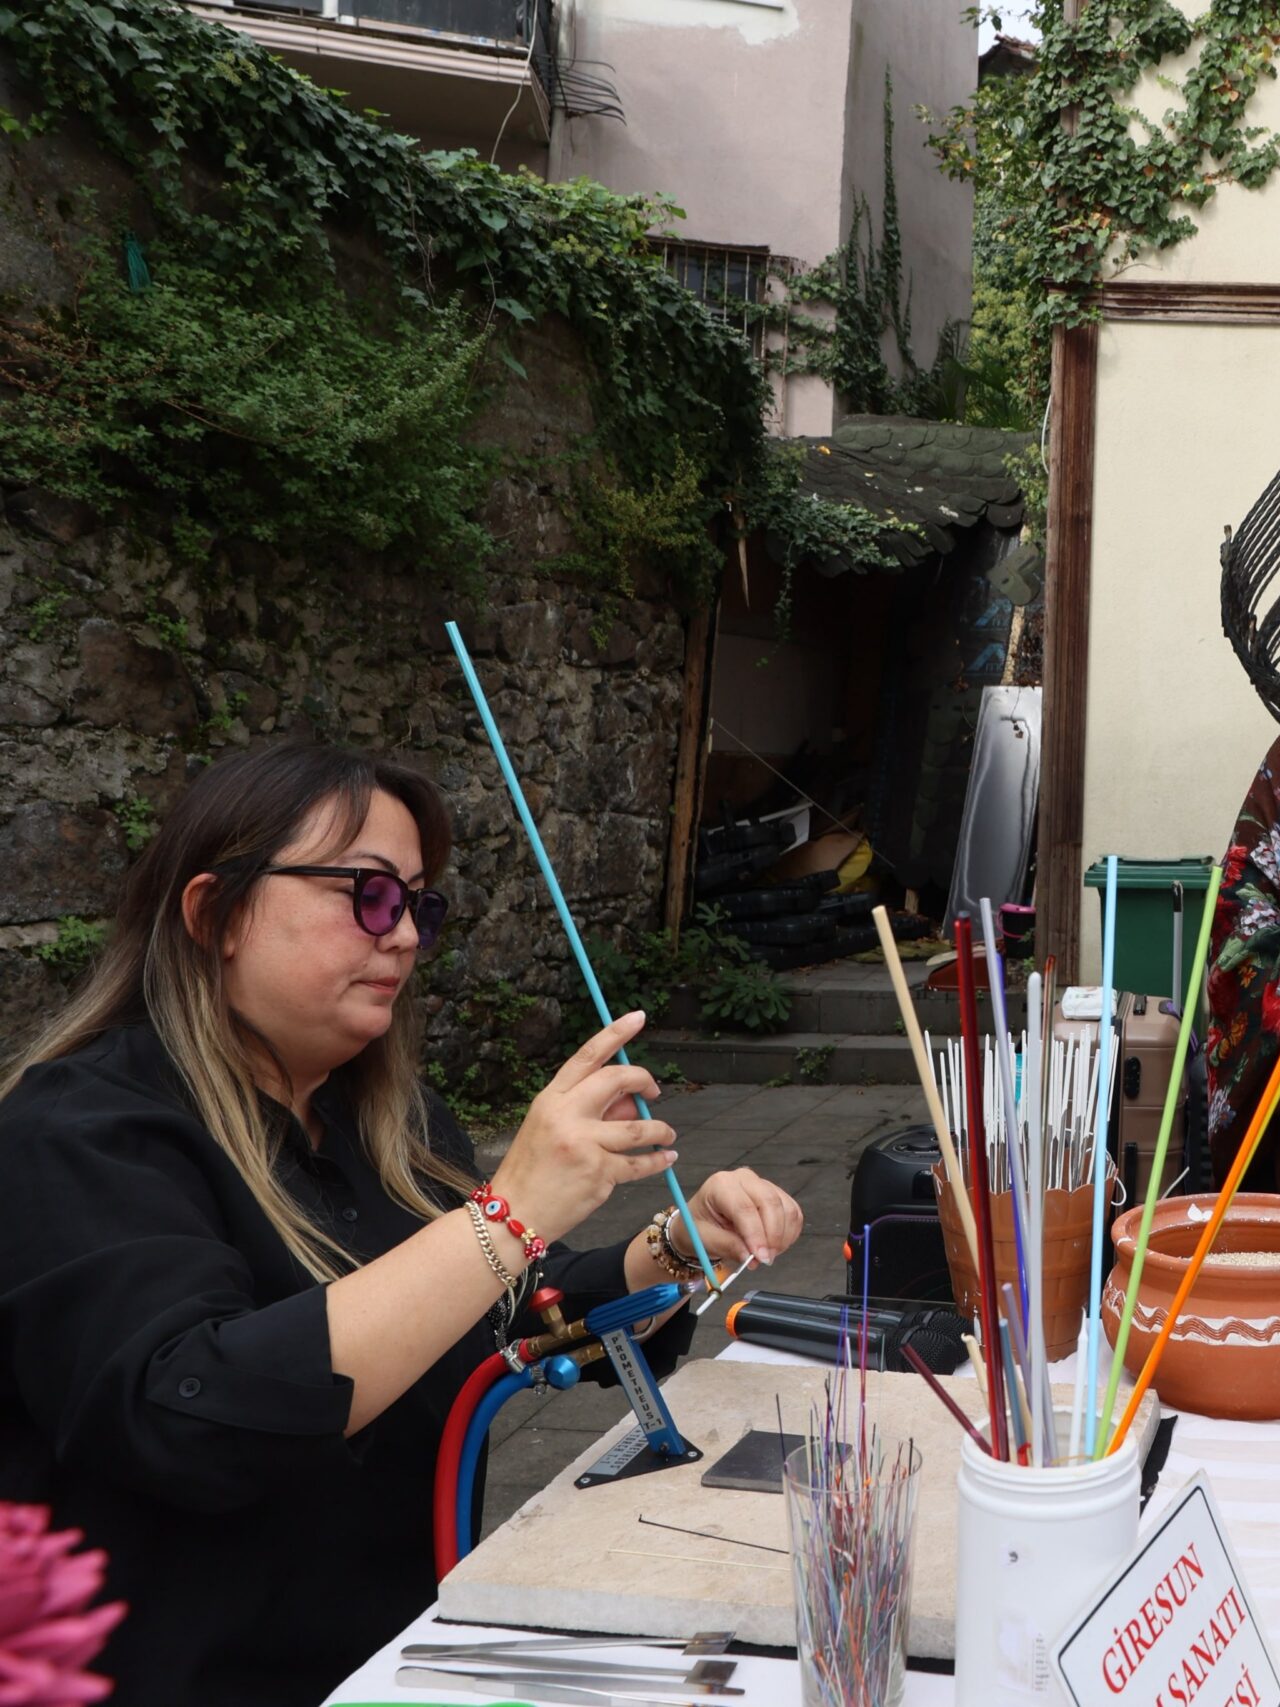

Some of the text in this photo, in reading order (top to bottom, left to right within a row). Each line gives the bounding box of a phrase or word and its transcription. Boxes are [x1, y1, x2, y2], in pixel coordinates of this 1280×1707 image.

[611, 1336, 655, 1420] PROMETHEUS
[643, 1418, 663, 1430] T-1
[1102, 1542, 1205, 1694] GİRESUN
[1167, 1586, 1246, 1707] SANATI
